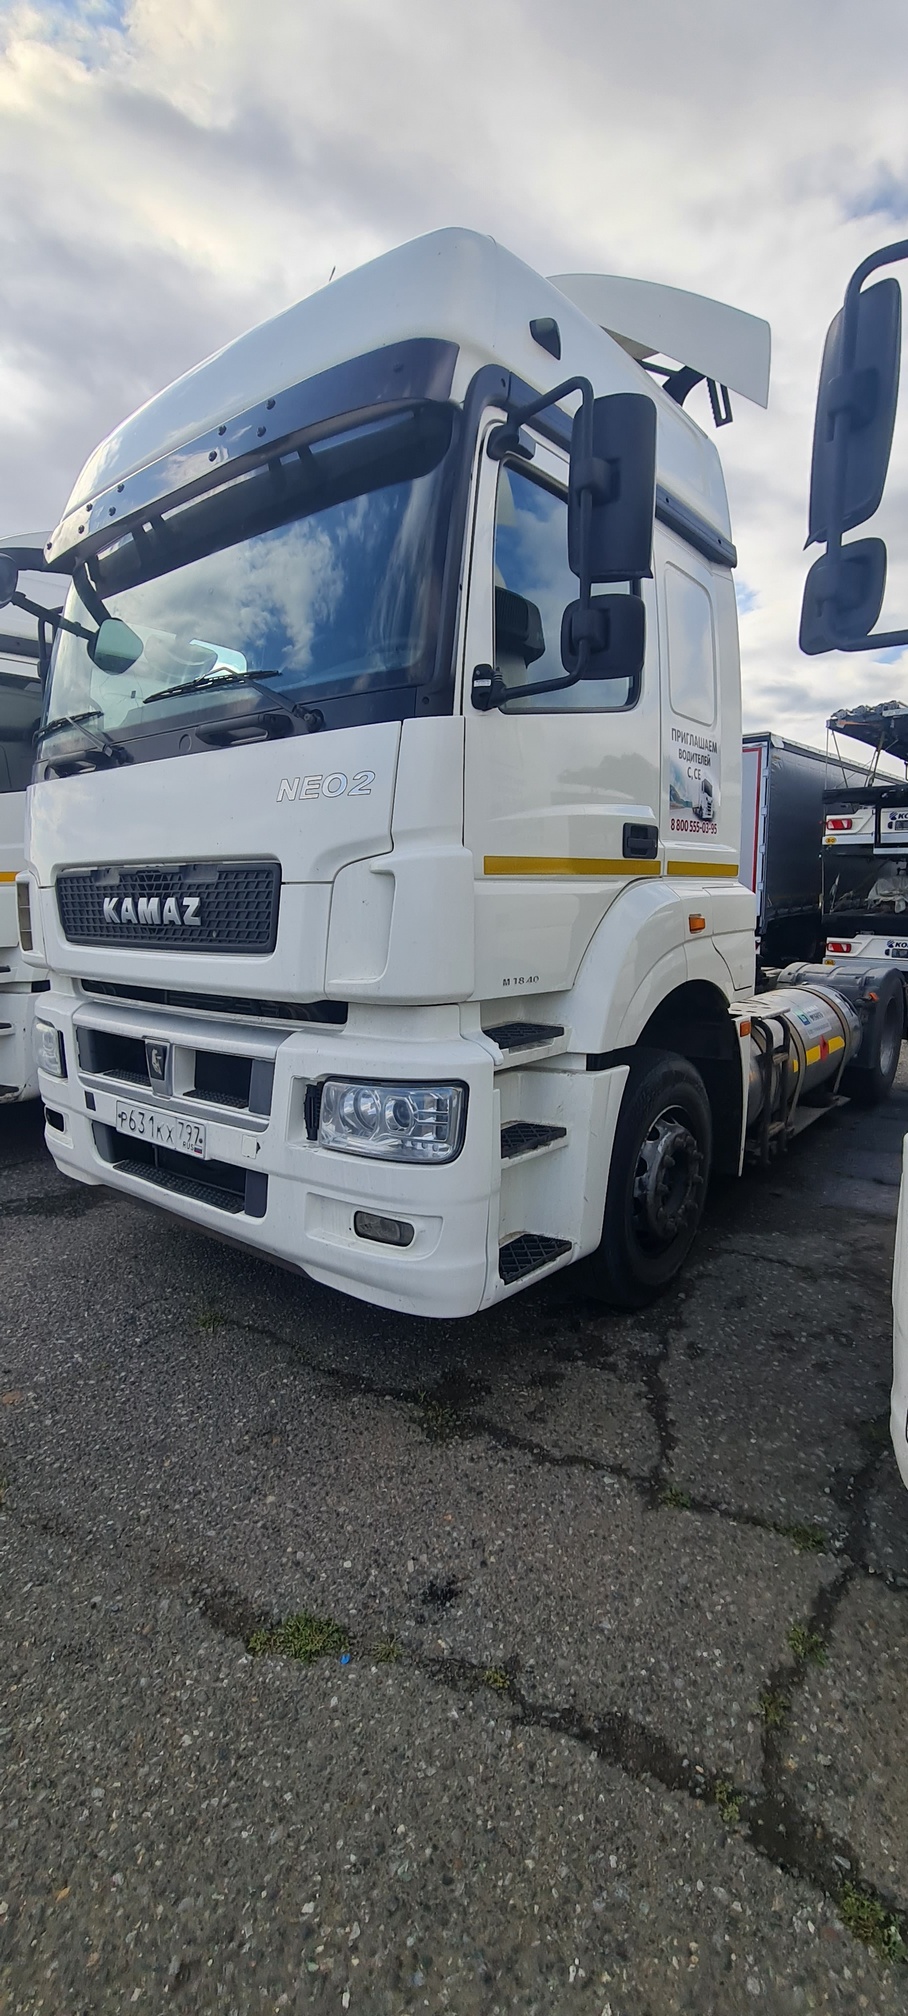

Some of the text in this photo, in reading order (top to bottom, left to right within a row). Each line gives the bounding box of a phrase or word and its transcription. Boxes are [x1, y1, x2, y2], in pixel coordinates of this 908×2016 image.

[672, 728, 717, 753] ПРИГЛАШАЕМ
[678, 748, 711, 767] ВОДИТЕЛЕЙ
[276, 770, 376, 803] NEO2
[102, 896, 202, 927] KAMAZ
[182, 1142, 194, 1151] RUS
